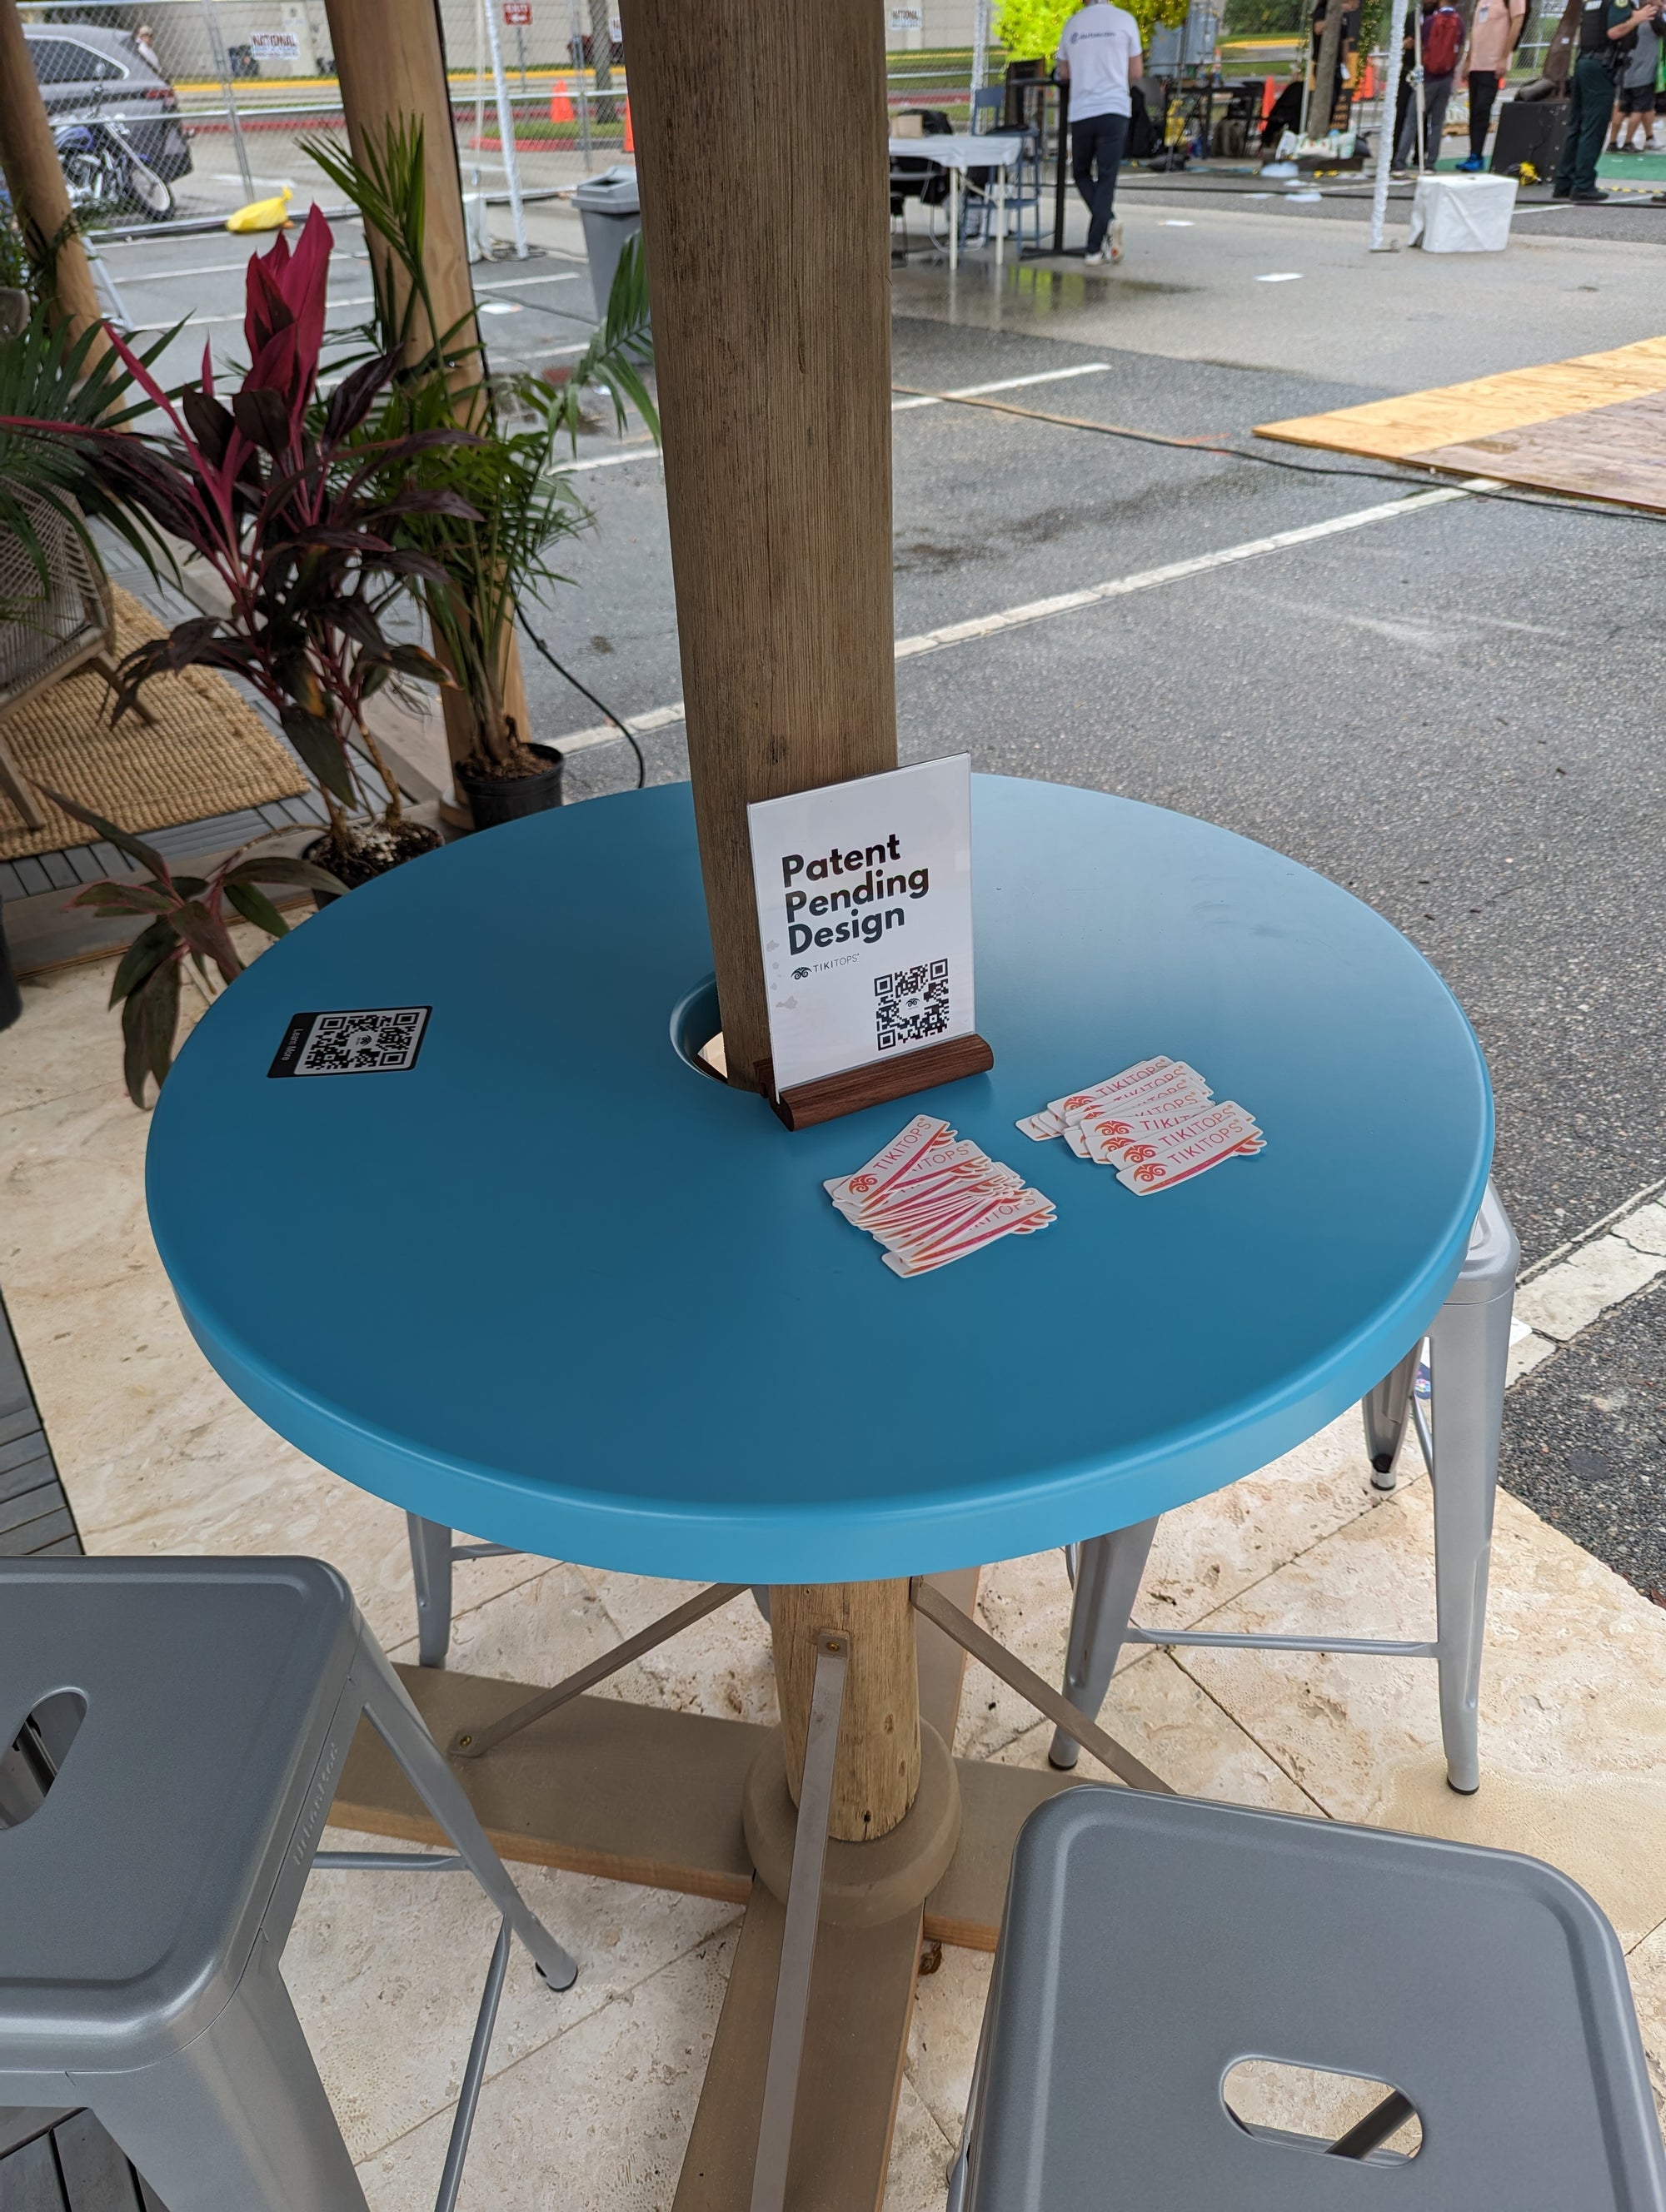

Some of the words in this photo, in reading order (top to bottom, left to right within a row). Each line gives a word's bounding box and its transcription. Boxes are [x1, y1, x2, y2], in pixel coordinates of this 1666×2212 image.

[252, 35, 296, 47] NATIONAL
[782, 834, 900, 888] Patent
[786, 868, 929, 924] Pending
[789, 908, 905, 955] Design
[288, 1029, 304, 1045] Learn
[282, 1045, 297, 1061] More
